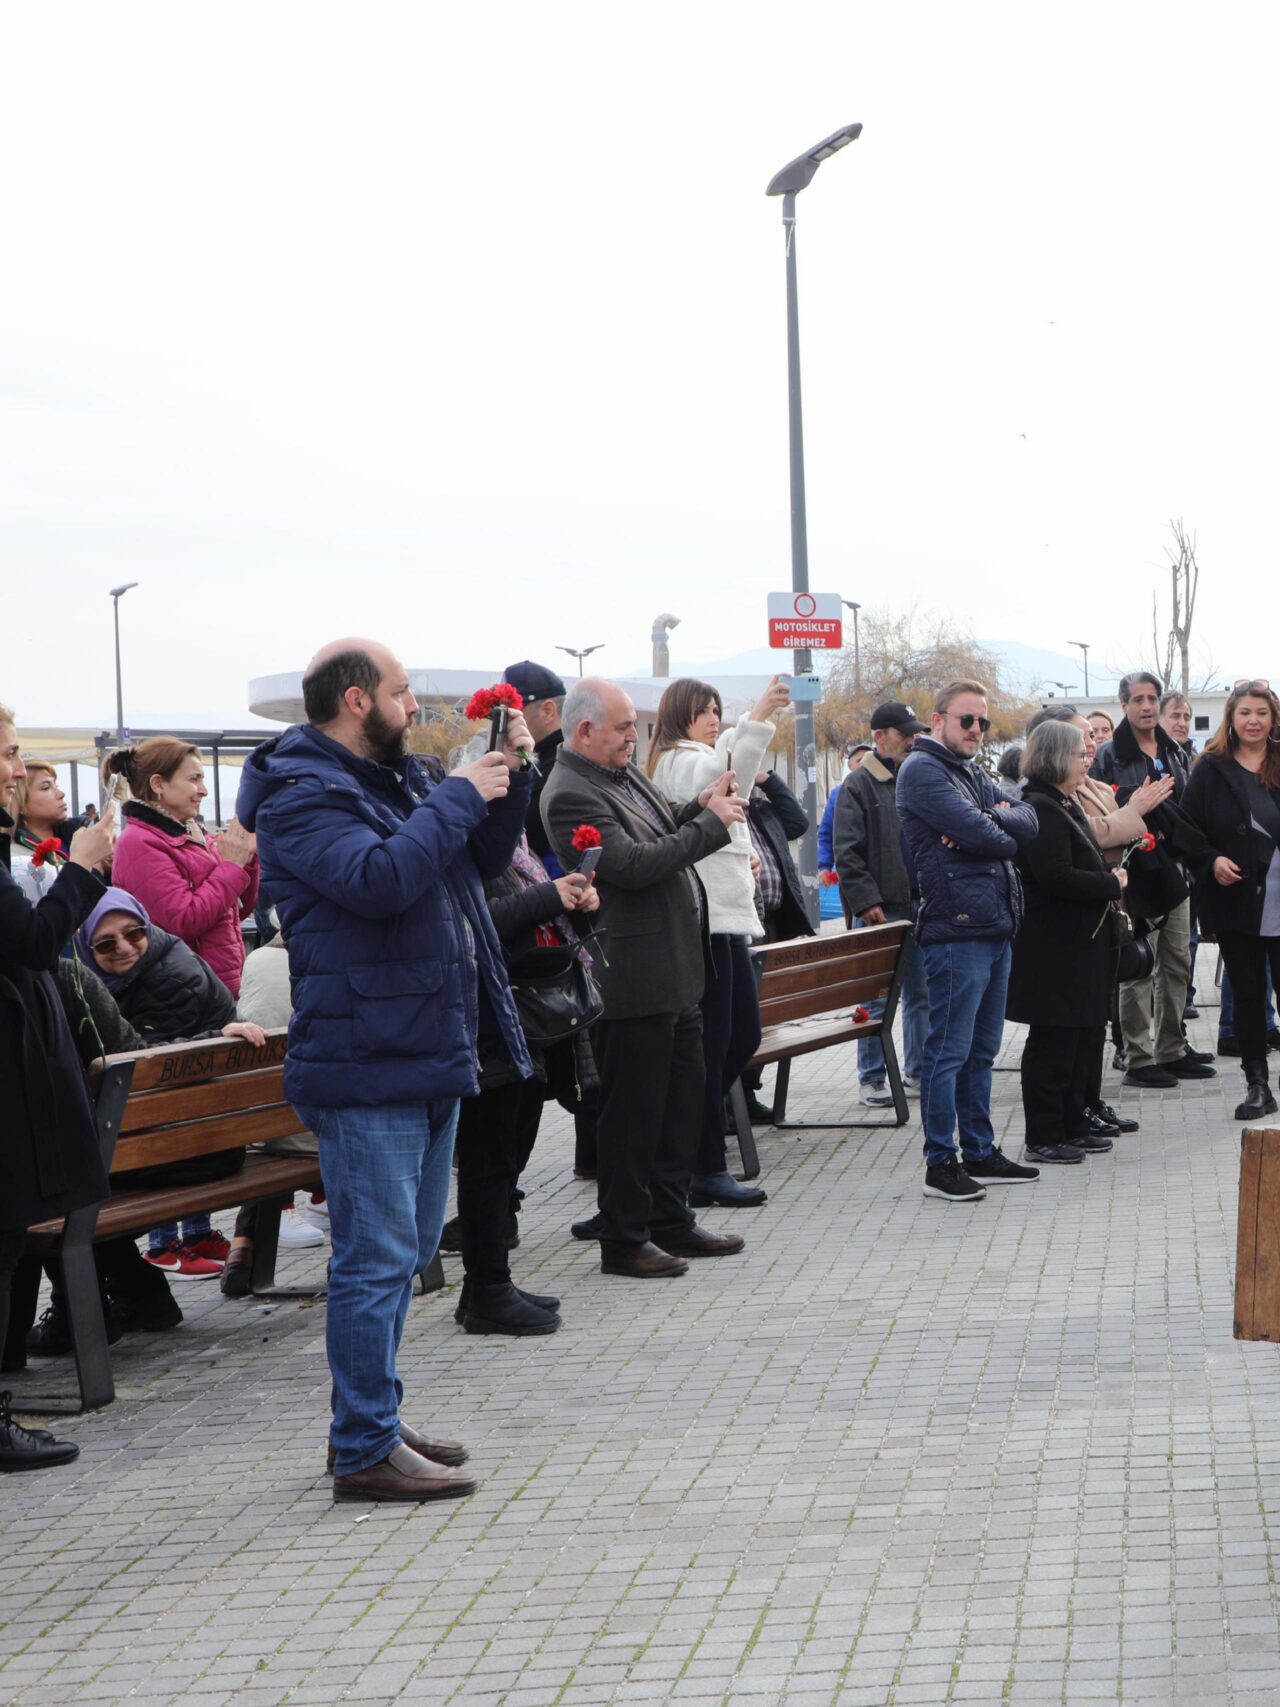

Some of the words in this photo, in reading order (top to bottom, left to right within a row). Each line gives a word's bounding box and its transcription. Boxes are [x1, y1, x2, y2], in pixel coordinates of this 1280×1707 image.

[774, 621, 836, 632] MOTOSİKLET
[783, 635, 826, 647] GİREMEZ
[160, 1051, 214, 1083] BURSA
